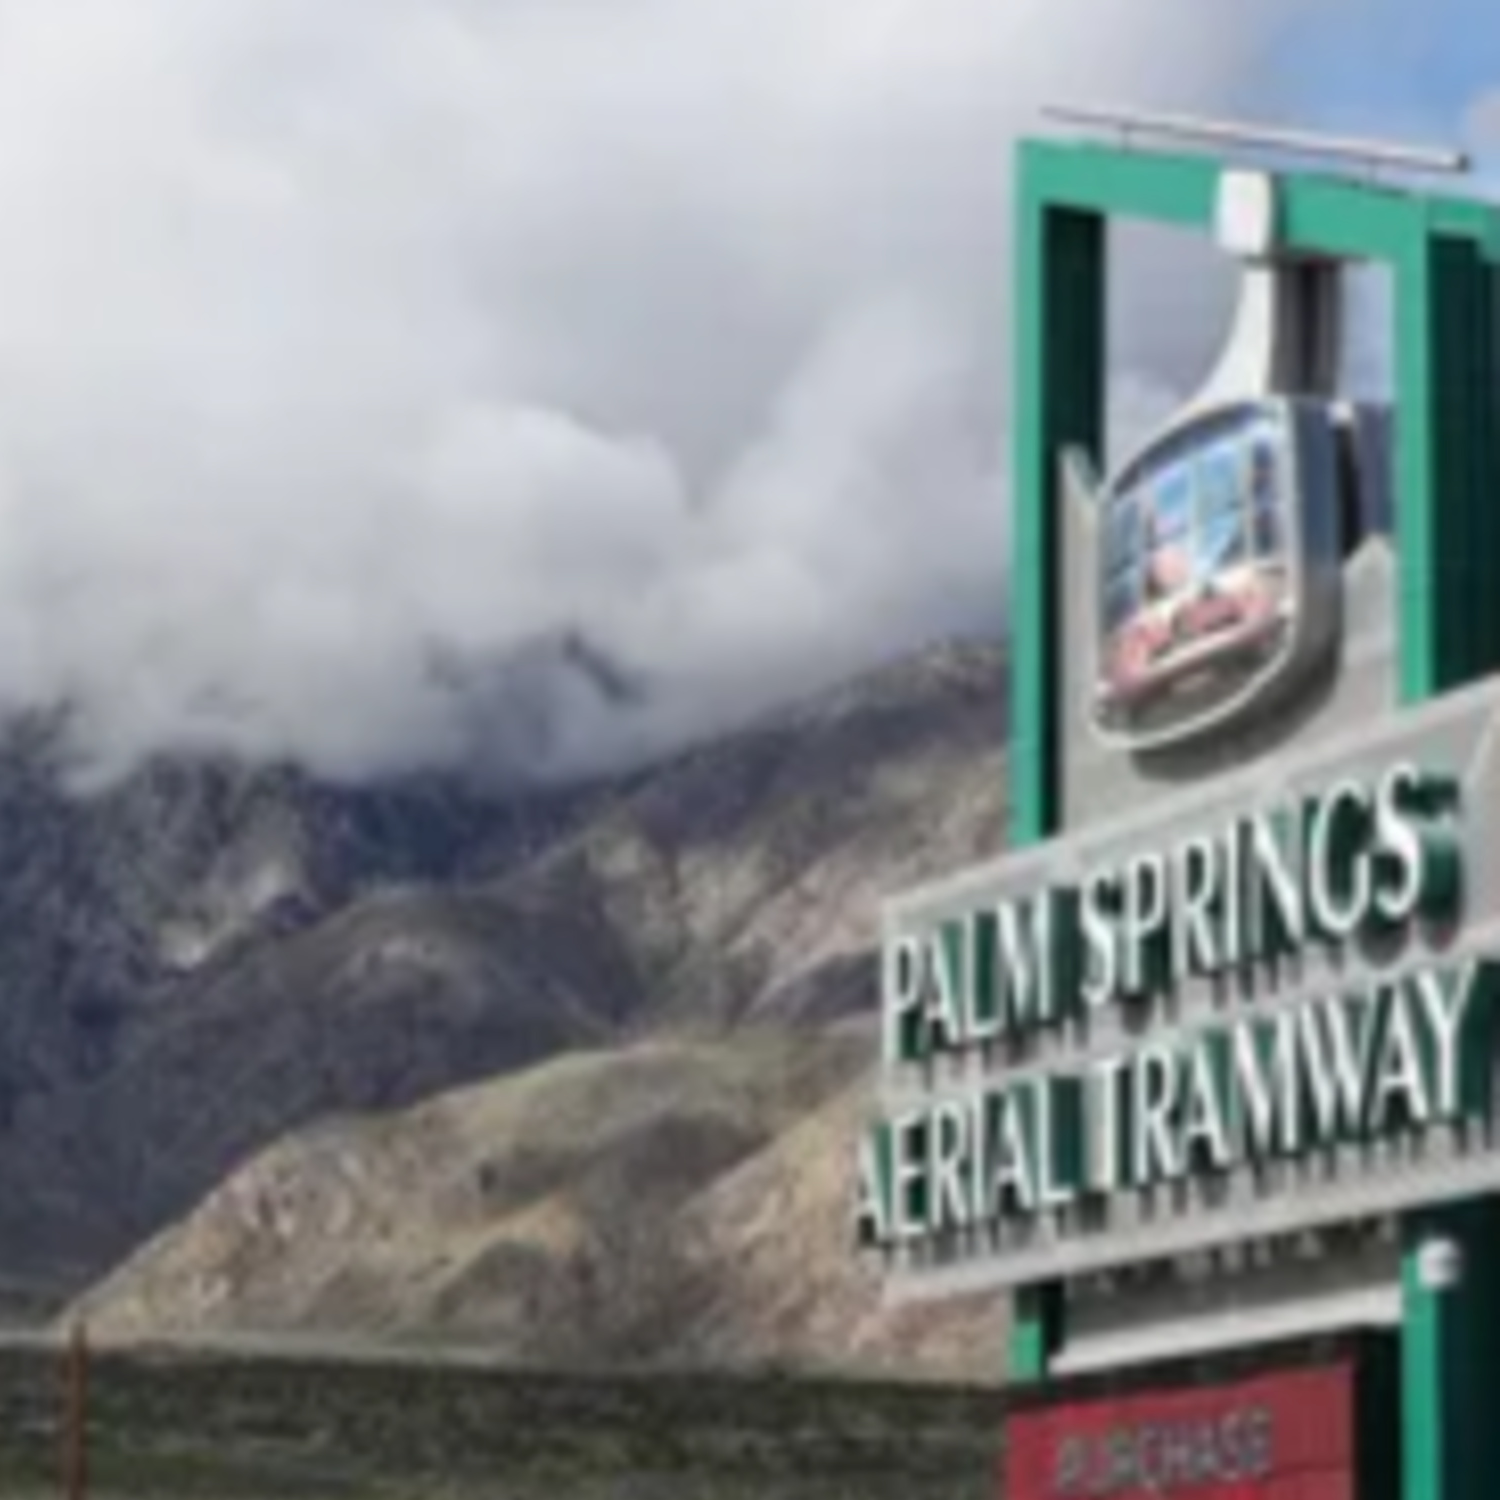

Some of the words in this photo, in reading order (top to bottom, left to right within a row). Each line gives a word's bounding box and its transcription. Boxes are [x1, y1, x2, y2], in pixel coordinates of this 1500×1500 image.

[884, 888, 1053, 1062] PALM
[1081, 762, 1422, 1006] SPRINGS
[858, 1080, 1075, 1239] AERIAL
[1094, 956, 1476, 1188] TRAMWAY
